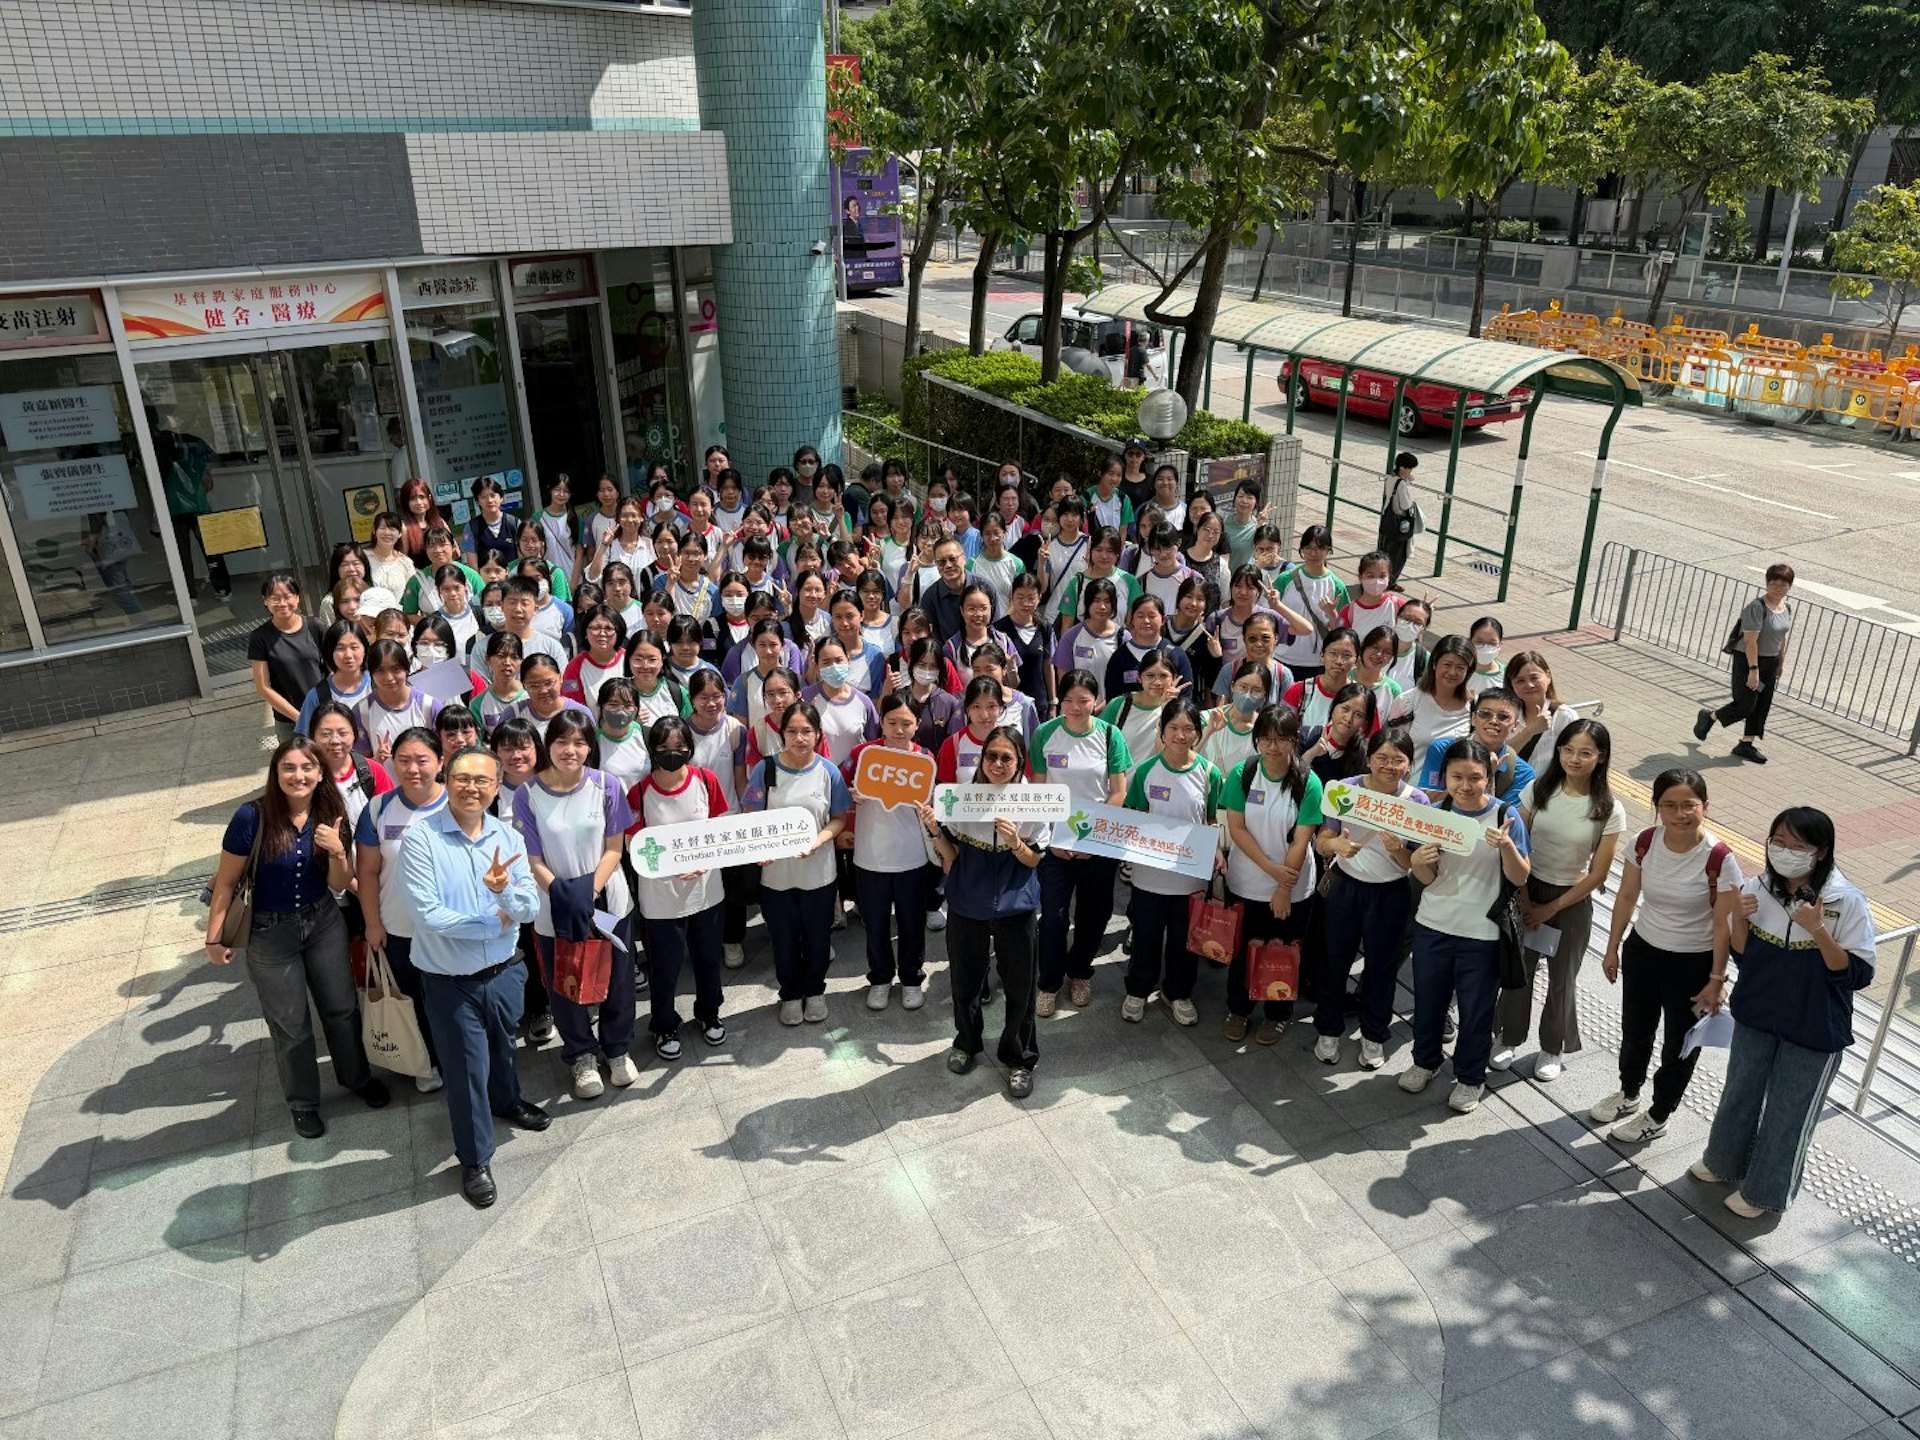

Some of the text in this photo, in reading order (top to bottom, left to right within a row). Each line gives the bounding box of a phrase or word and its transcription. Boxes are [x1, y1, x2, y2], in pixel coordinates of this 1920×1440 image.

[173, 282, 337, 306] 基督教家庭服務中心
[418, 276, 479, 297] 西醫診症
[866, 763, 924, 789] CFSC
[963, 792, 1065, 802] 基督教家庭服務中心
[1016, 805, 1041, 813] Service
[671, 819, 809, 850] 基督教家庭服務中心
[673, 835, 811, 864] Christian Family Service Centre
